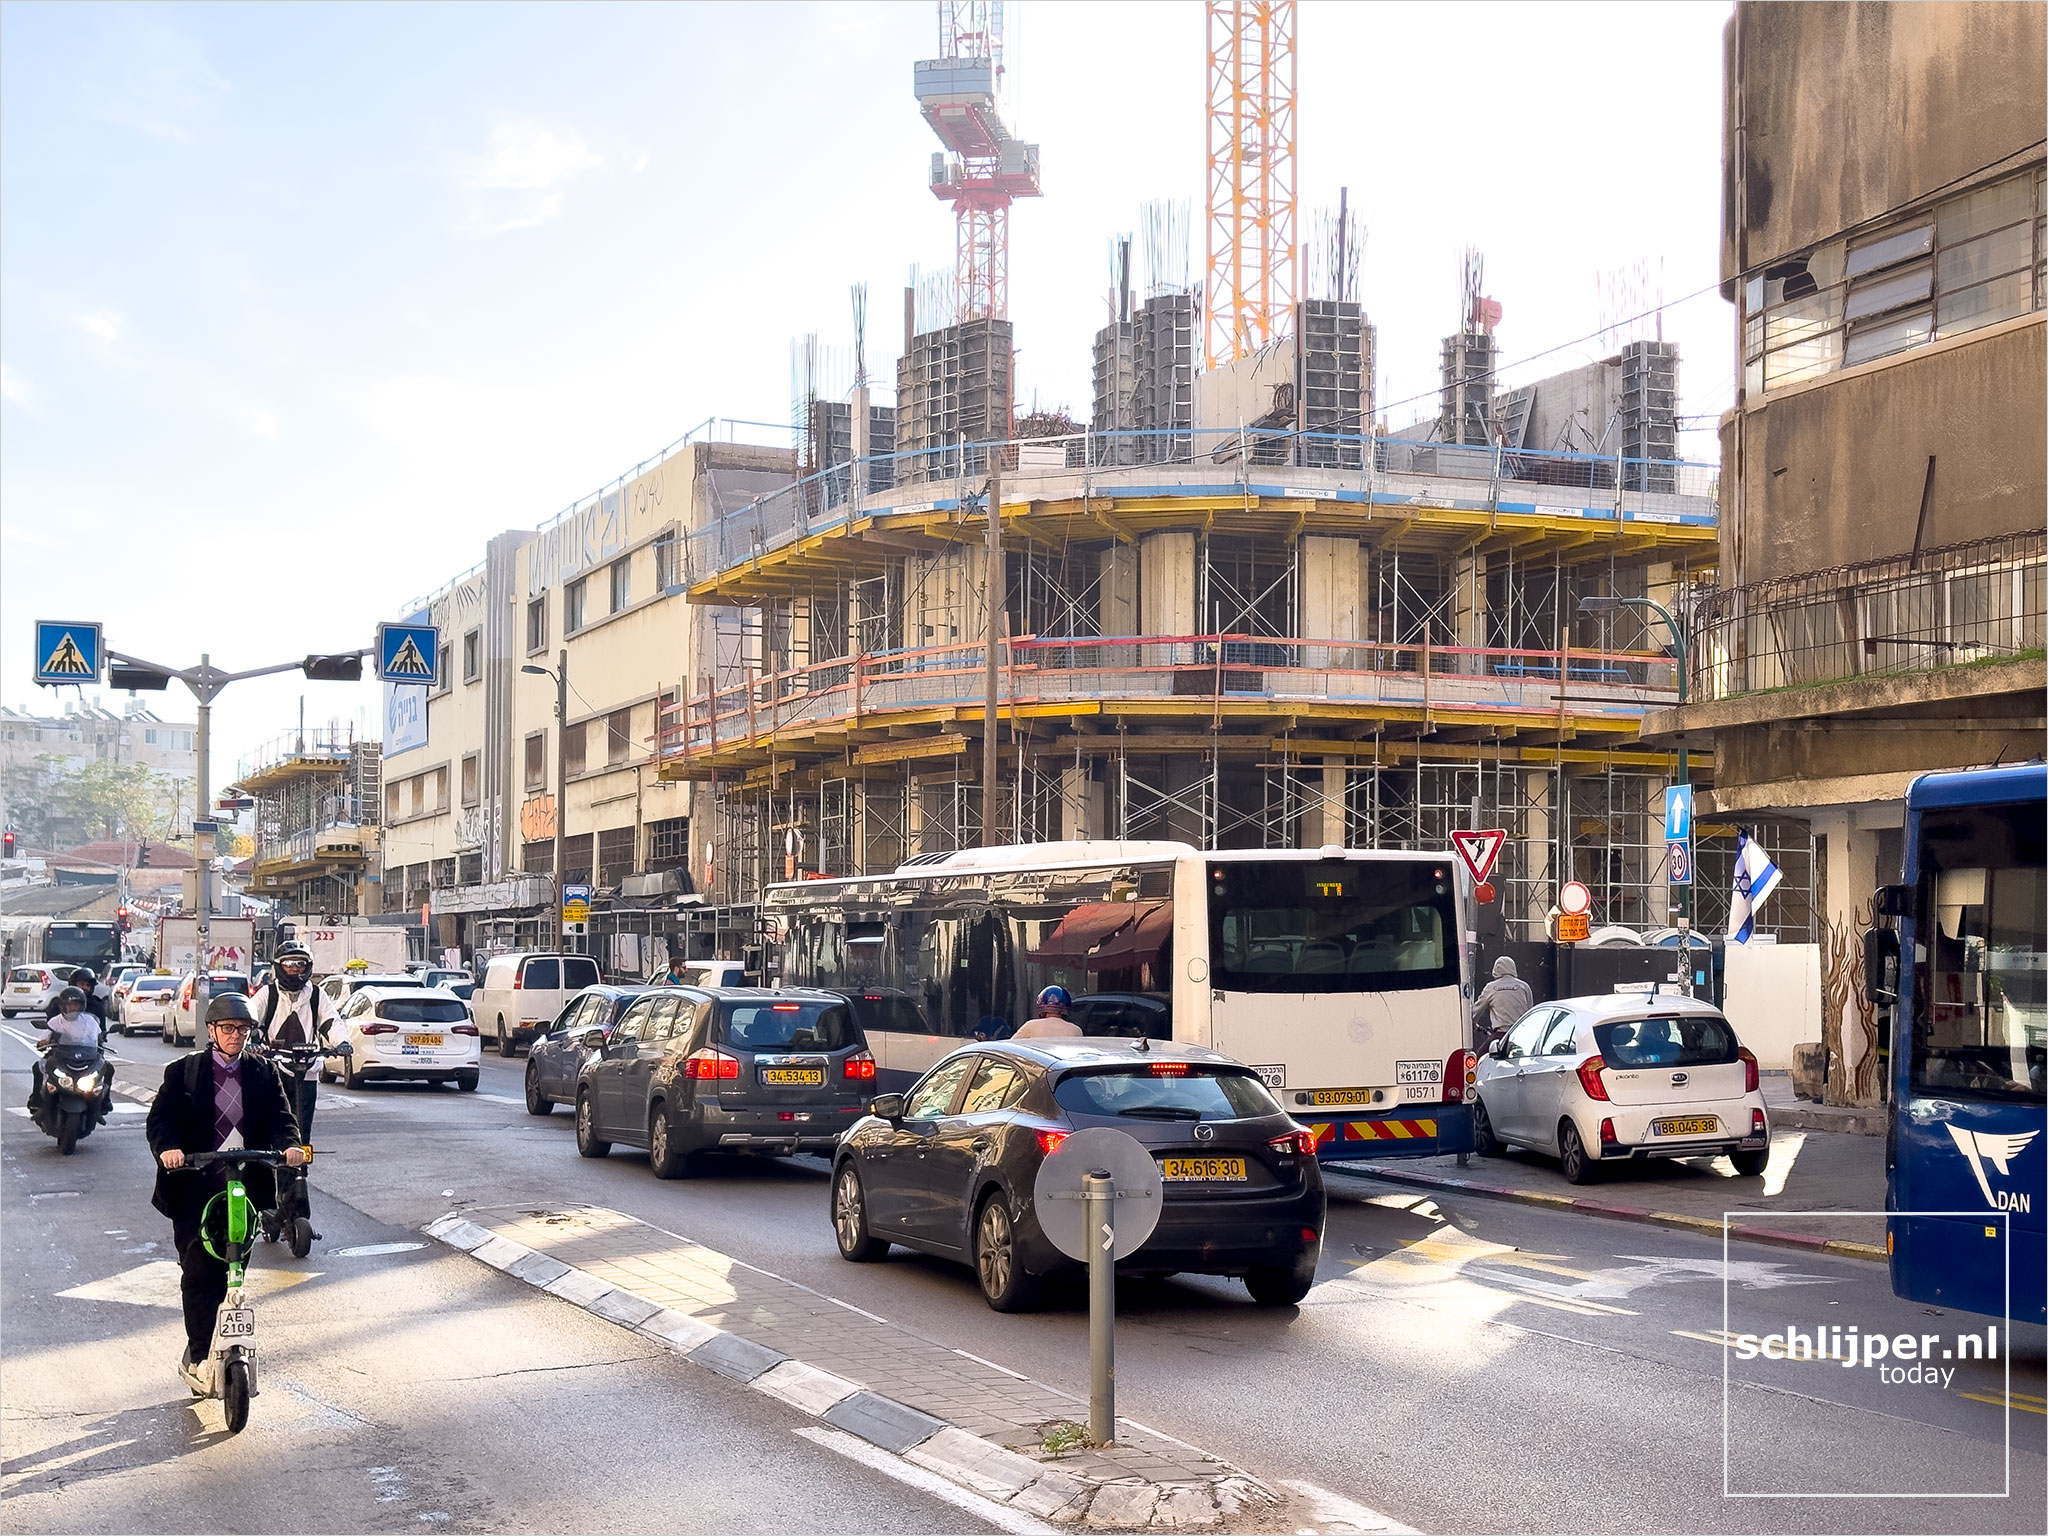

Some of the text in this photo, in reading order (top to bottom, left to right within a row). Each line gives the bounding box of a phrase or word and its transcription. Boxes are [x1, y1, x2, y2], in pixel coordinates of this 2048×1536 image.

[1672, 854, 1683, 870] 30
[315, 931, 335, 941] 223
[1430, 1062, 1441, 1070] איך
[1405, 1086, 1435, 1099] 10571
[1997, 1190, 2030, 1214] DAN
[225, 1312, 243, 1323] AE
[222, 1323, 252, 1334] 2109
